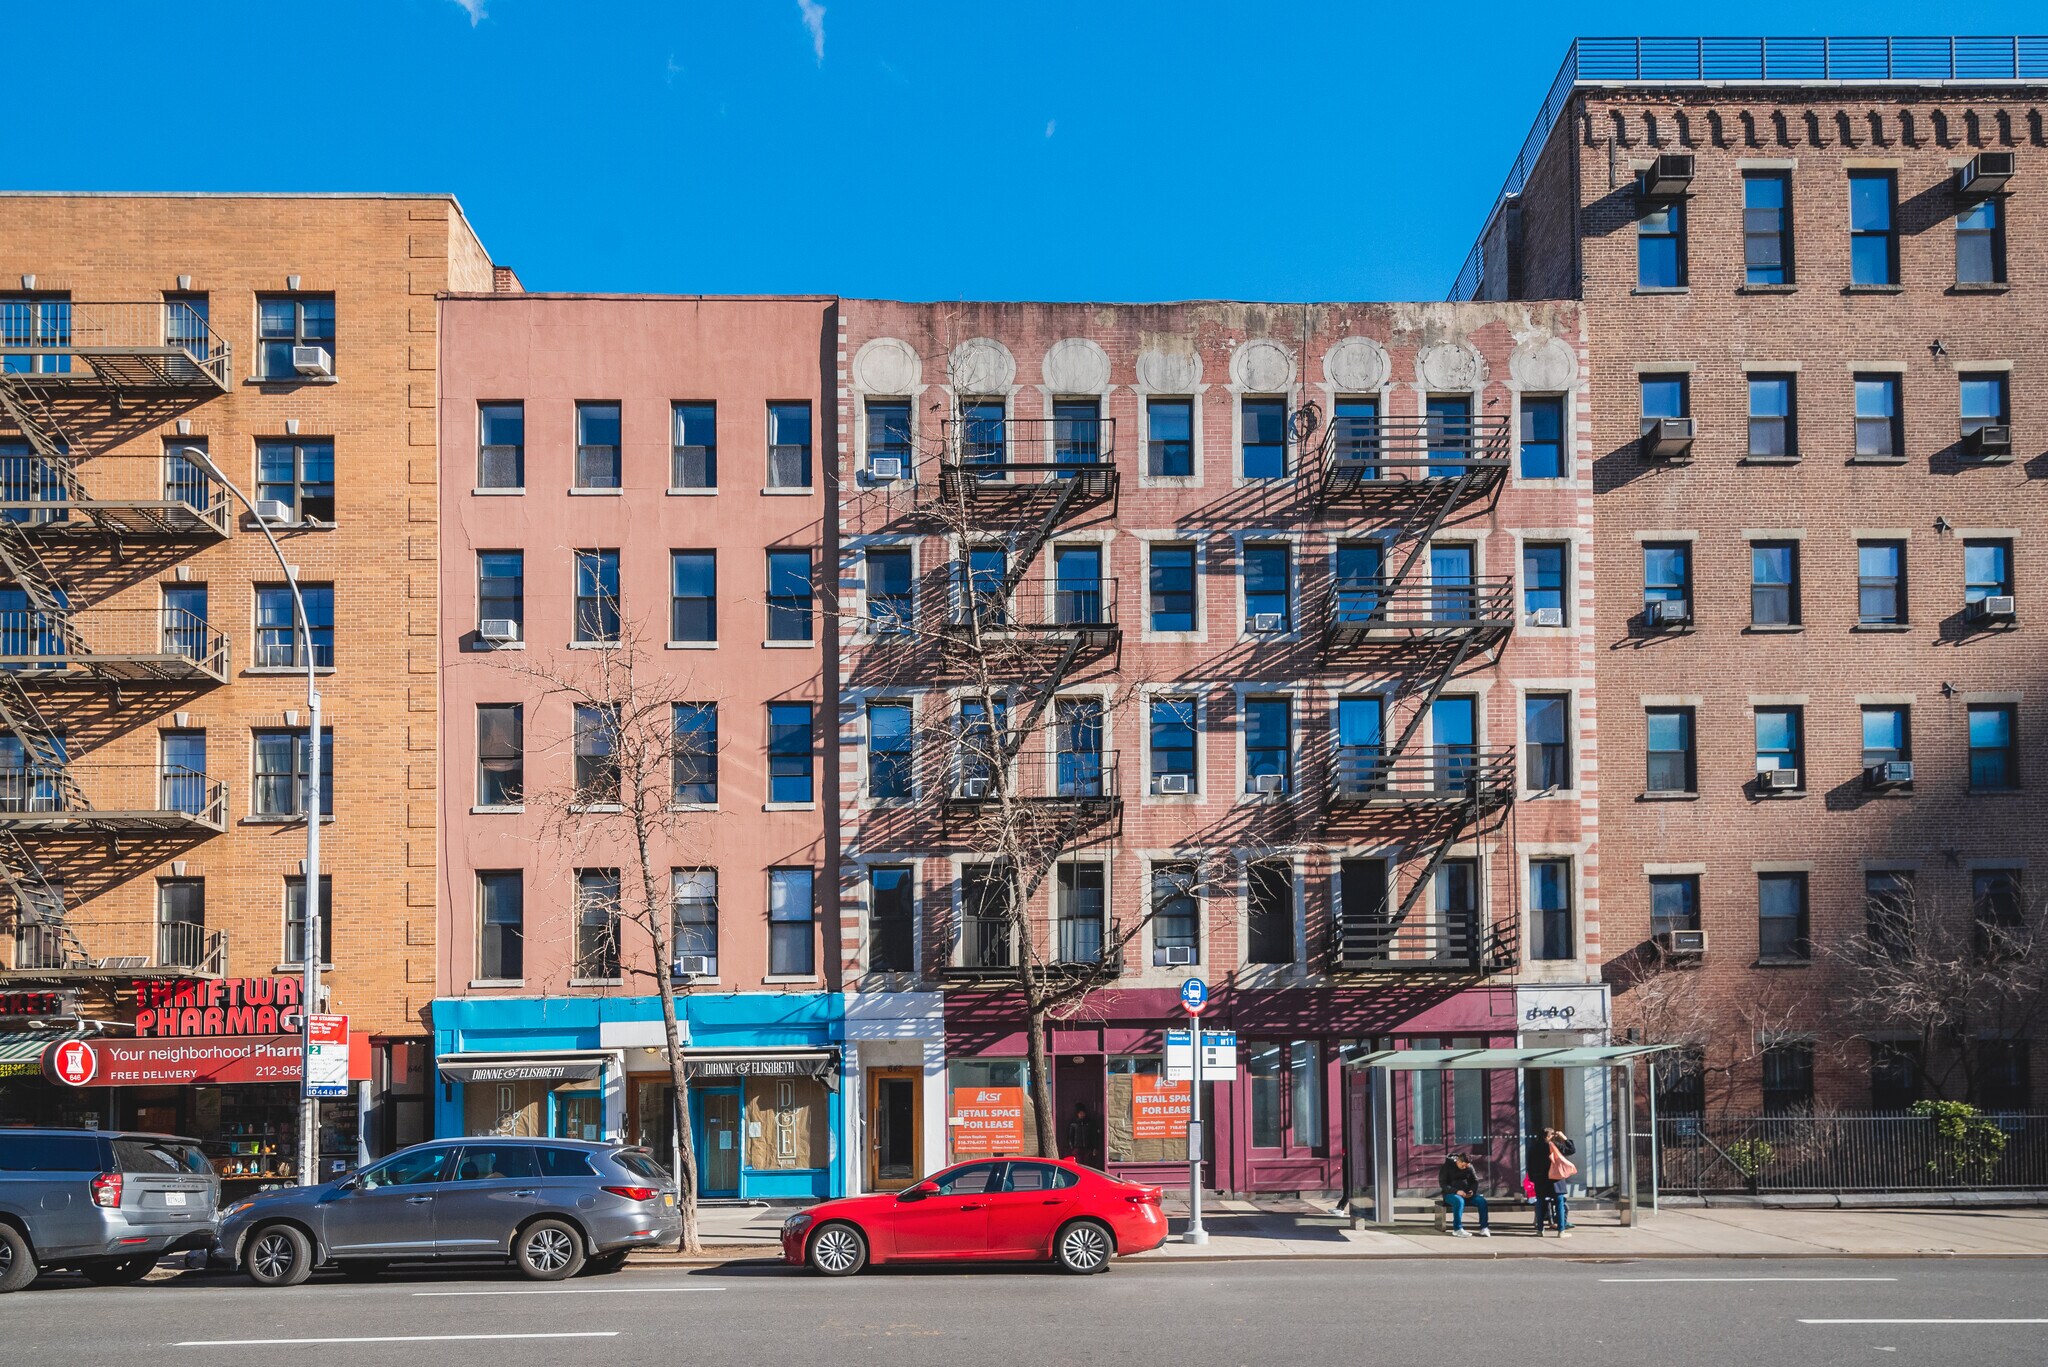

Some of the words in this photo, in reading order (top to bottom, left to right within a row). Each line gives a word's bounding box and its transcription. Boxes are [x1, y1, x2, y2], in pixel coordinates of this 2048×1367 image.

[132, 977, 304, 1007] THRIFTWA
[136, 1005, 304, 1036] PHARMAC
[110, 1048, 143, 1061] Your
[149, 1046, 251, 1062] neighborhood
[255, 1045, 302, 1058] Pharm
[311, 1045, 319, 1055] 2
[111, 1071, 139, 1079] FREE
[143, 1070, 198, 1079] DELIVERY
[256, 1066, 302, 1076] 212-956
[472, 1069, 504, 1080] DIANNE
[503, 1068, 519, 1079] &
[519, 1067, 565, 1078] ELISABETH
[705, 1063, 736, 1075] DIANNE
[735, 1062, 751, 1075] &
[752, 1061, 795, 1074] ELISABETH
[501, 1087, 512, 1111] D
[780, 1083, 792, 1107] D
[1135, 1095, 1168, 1103] RETAIL
[1169, 1094, 1191, 1103] SPAC
[957, 1109, 990, 1117] RETAIL
[991, 1109, 1021, 1117] SPACE
[1163, 1106, 1191, 1114] LEASE
[781, 1129, 792, 1154] E
